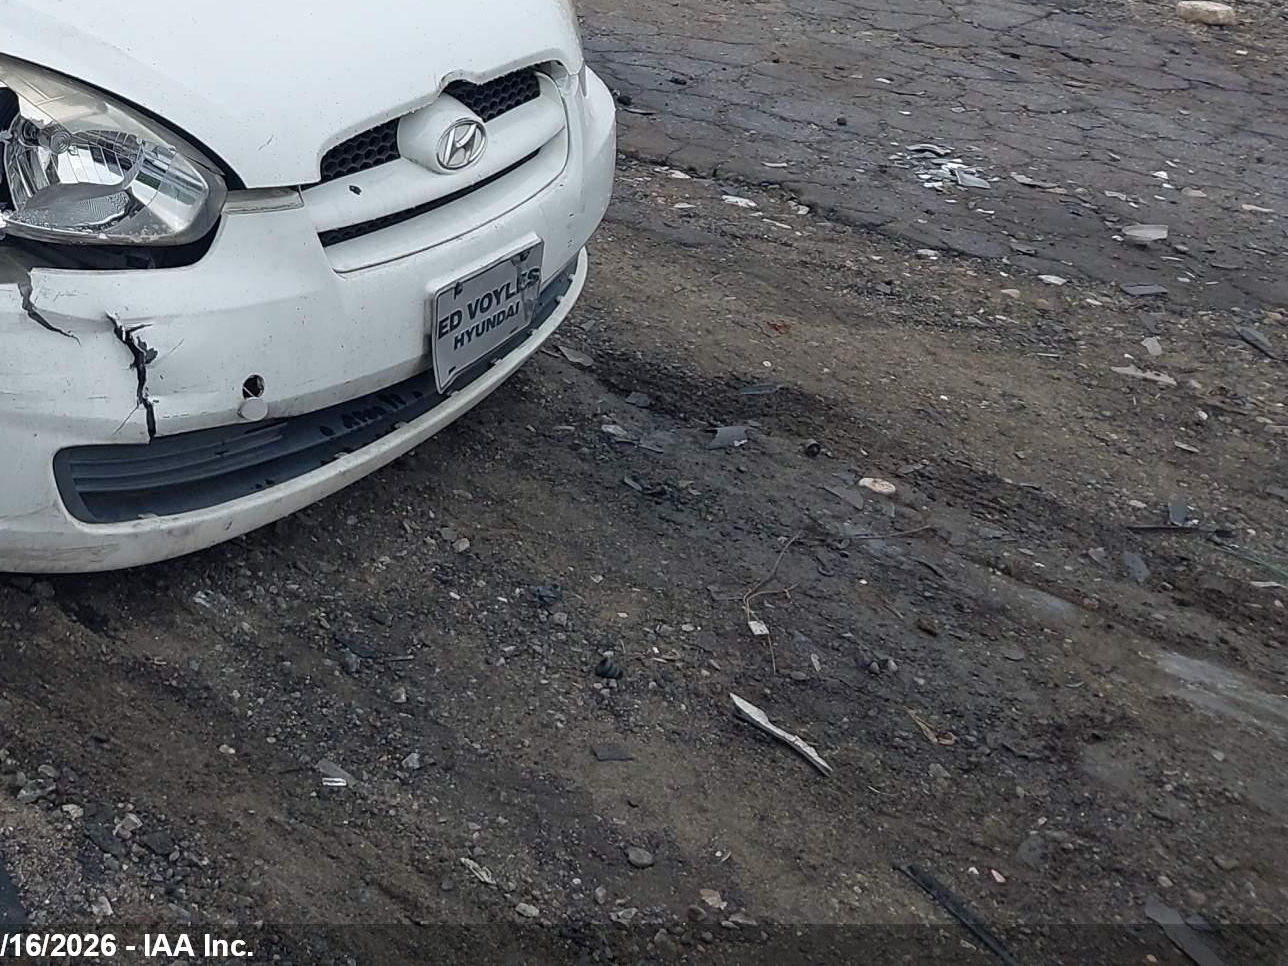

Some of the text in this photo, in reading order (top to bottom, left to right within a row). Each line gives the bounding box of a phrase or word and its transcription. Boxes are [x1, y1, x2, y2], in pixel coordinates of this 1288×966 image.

[438, 267, 540, 340] ED VOYLES
[454, 300, 520, 350] HYUNDAI
